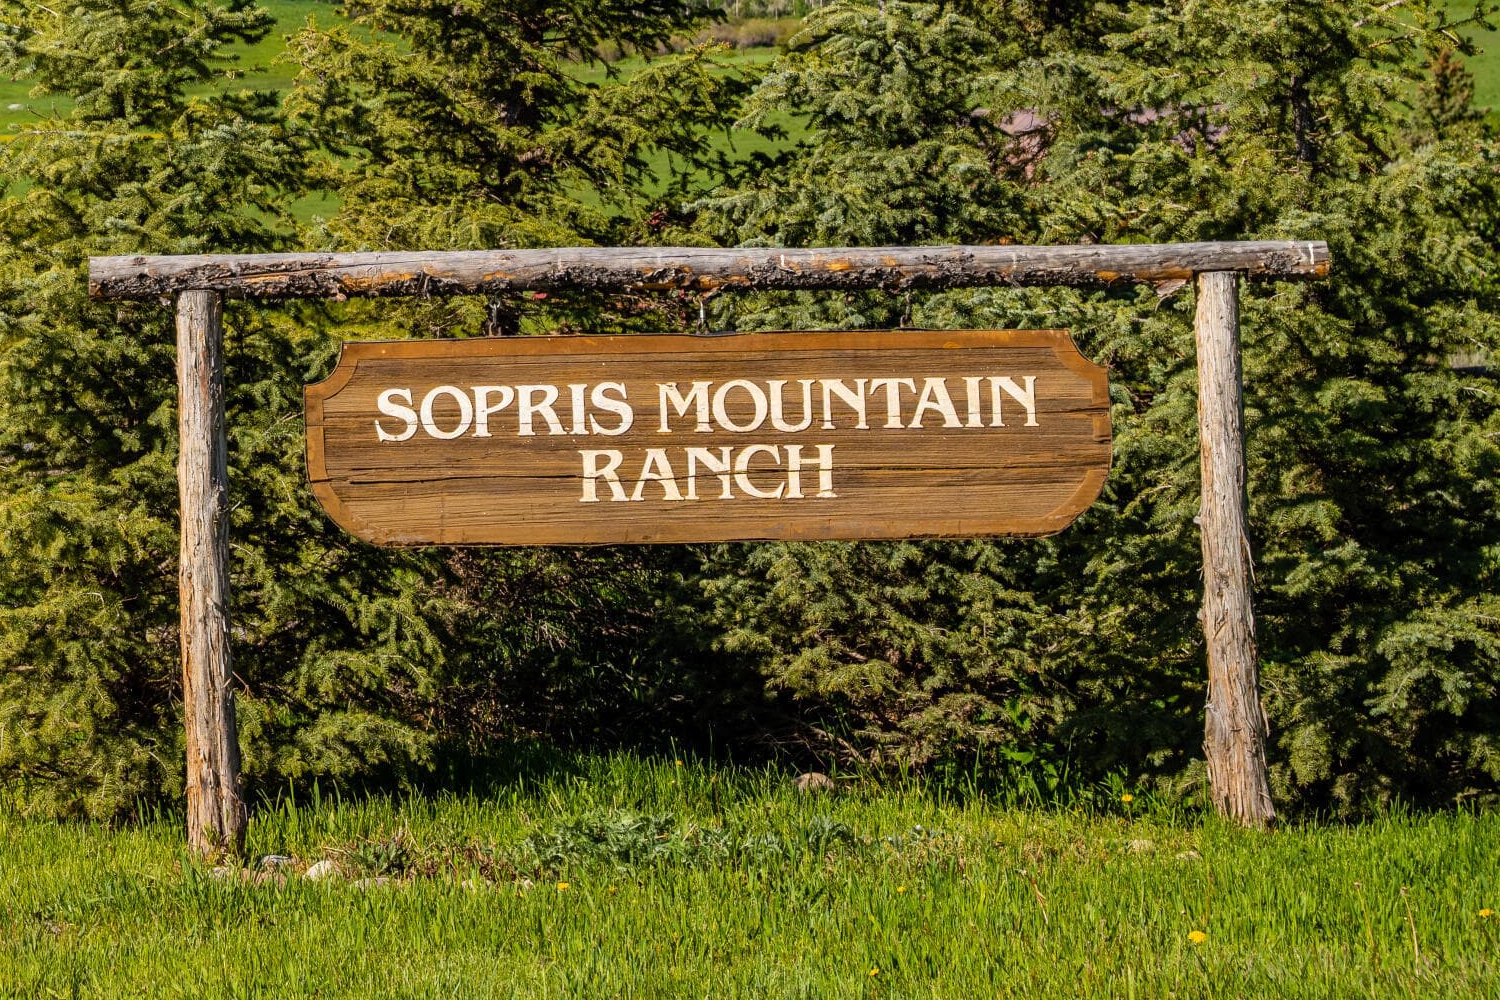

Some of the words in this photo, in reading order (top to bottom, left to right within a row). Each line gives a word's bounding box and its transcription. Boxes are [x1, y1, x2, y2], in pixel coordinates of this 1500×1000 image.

[375, 382, 633, 441] SOPRIS
[656, 376, 1039, 432] MOUNTAIN
[578, 445, 837, 502] RANCH
